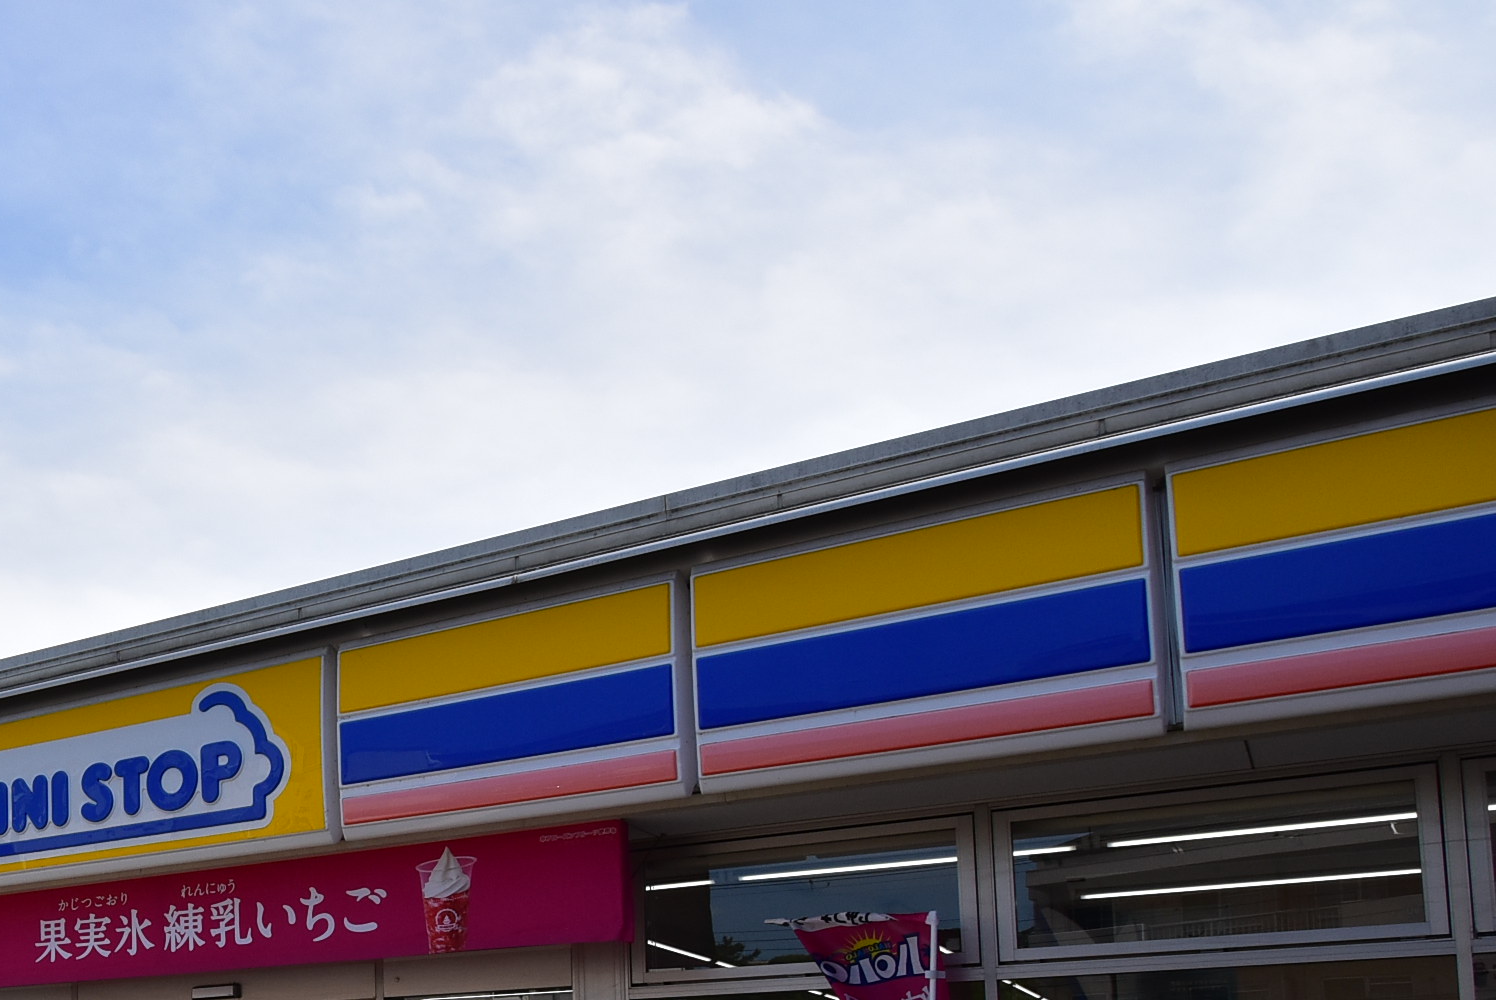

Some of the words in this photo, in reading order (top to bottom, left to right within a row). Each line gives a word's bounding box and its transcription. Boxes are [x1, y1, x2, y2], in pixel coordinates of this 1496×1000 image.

[81, 740, 243, 823] STOP
[58, 893, 129, 912] かじつごおり
[181, 879, 236, 898] れんにゅう
[34, 908, 155, 963] 果実氷
[164, 887, 387, 952] 練乳いちご
